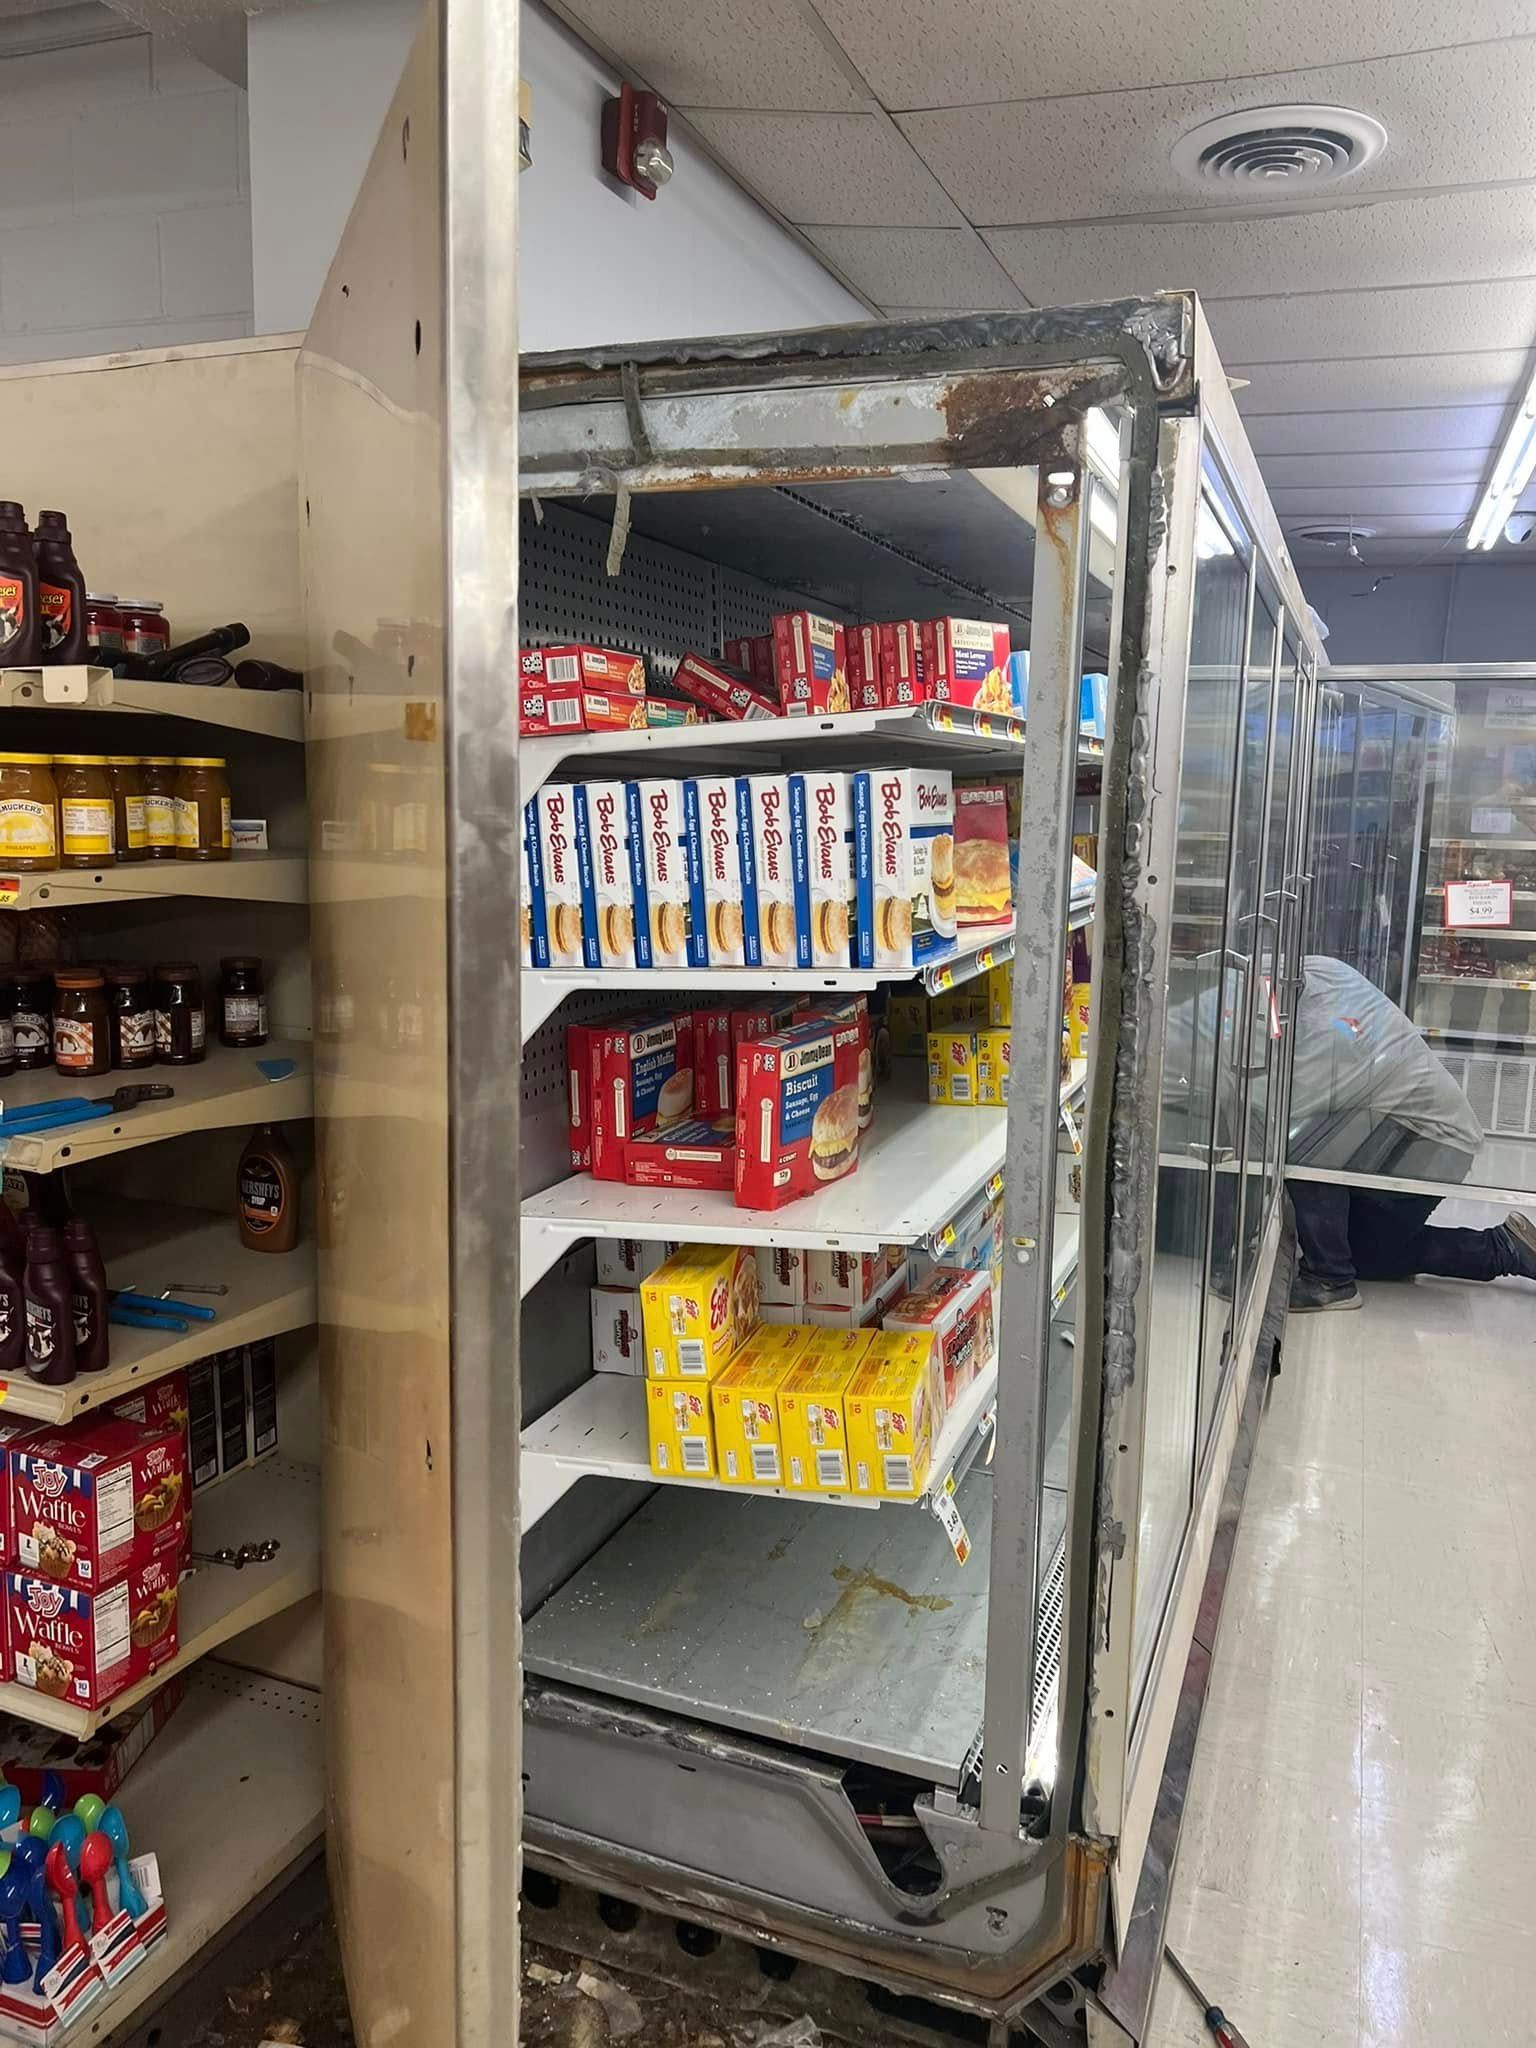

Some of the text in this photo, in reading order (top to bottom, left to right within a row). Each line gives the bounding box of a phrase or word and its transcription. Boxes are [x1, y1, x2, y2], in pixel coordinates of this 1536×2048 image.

[858, 780, 866, 809] Sausage,
[917, 784, 948, 810] Bob Evans
[859, 810, 867, 823] Egg
[882, 777, 902, 876] Bob Evans
[547, 792, 567, 884] Bob Evans
[597, 792, 618, 885] Bob Evans
[650, 789, 670, 882] Bob Evans
[708, 786, 729, 880] Bob Evans
[761, 786, 782, 881] Bob Evans
[816, 783, 837, 879] Bob Evans
[860, 829, 868, 854] Cheese
[796, 834, 804, 858] Cheese
[646, 1033, 662, 1048] Jimmy
[662, 1029, 674, 1042] Dean
[636, 1050, 674, 1076] English Muffin
[800, 1048, 818, 1066] Jimmy
[818, 1044, 832, 1059] Dean
[786, 1074, 818, 1096] Biscuit
[786, 1092, 818, 1110] Sausage, Egg
[790, 1108, 810, 1119] Cheese
[241, 1180, 280, 1199] HERSHEY'S
[650, 1292, 657, 1302] 10
[656, 1388, 663, 1398] 10
[722, 1394, 730, 1404] 10
[786, 1400, 794, 1410] 10
[854, 1404, 862, 1414] 10
[33, 1465, 66, 1496] Joy
[18, 1486, 86, 1528] Waffle
[80, 1562, 90, 1572] 10
[28, 1585, 64, 1618] Joy
[14, 1606, 84, 1648] Waffle
[78, 1682, 88, 1690] 10
